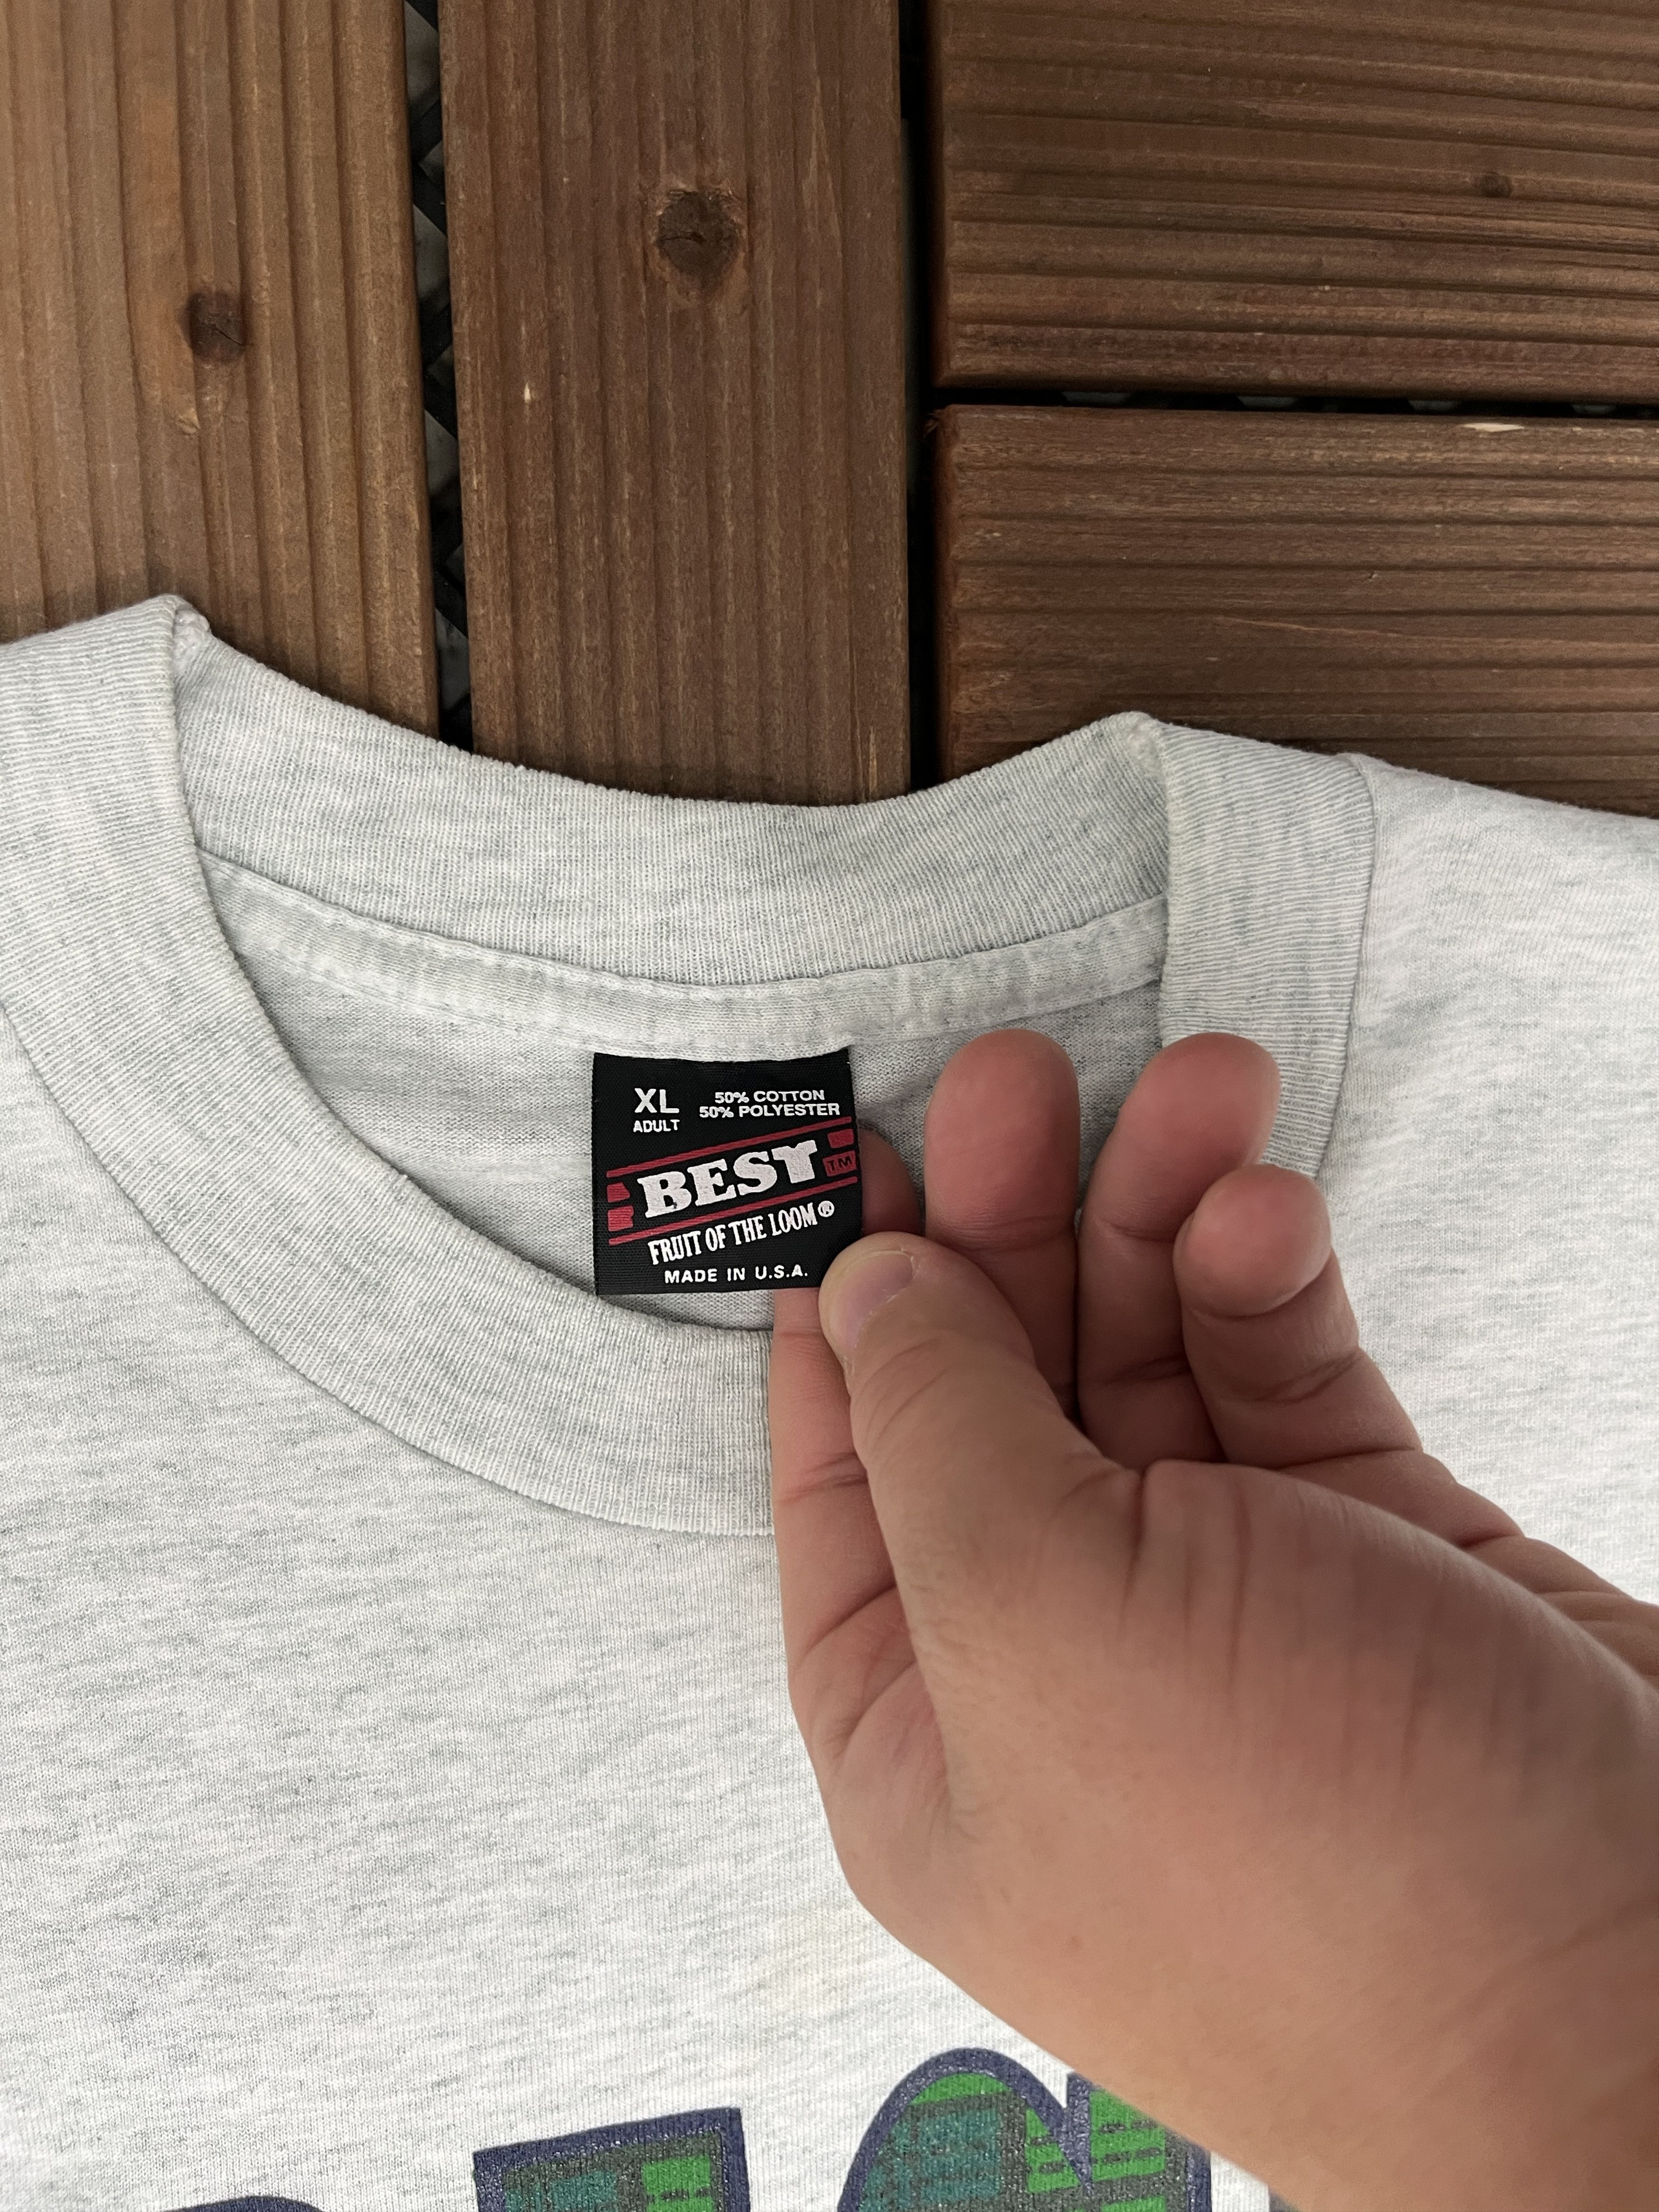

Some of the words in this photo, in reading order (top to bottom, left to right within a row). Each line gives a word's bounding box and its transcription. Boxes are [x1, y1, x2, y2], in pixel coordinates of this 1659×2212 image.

[634, 1088, 680, 1113] XL
[715, 1092, 749, 1104] 50%
[754, 1090, 825, 1102] COTTON
[699, 1106, 734, 1118] 50%
[739, 1103, 840, 1117] POLYESTER
[633, 1119, 680, 1132] ADULT
[827, 1157, 852, 1173] TM
[637, 1140, 817, 1218] BEST
[647, 1231, 702, 1265] FRUIT
[705, 1223, 726, 1251] OF
[728, 1214, 767, 1245] THE
[664, 1268, 717, 1284] MADE
[727, 1267, 746, 1281] IN
[755, 1264, 808, 1279] U.S.A.
